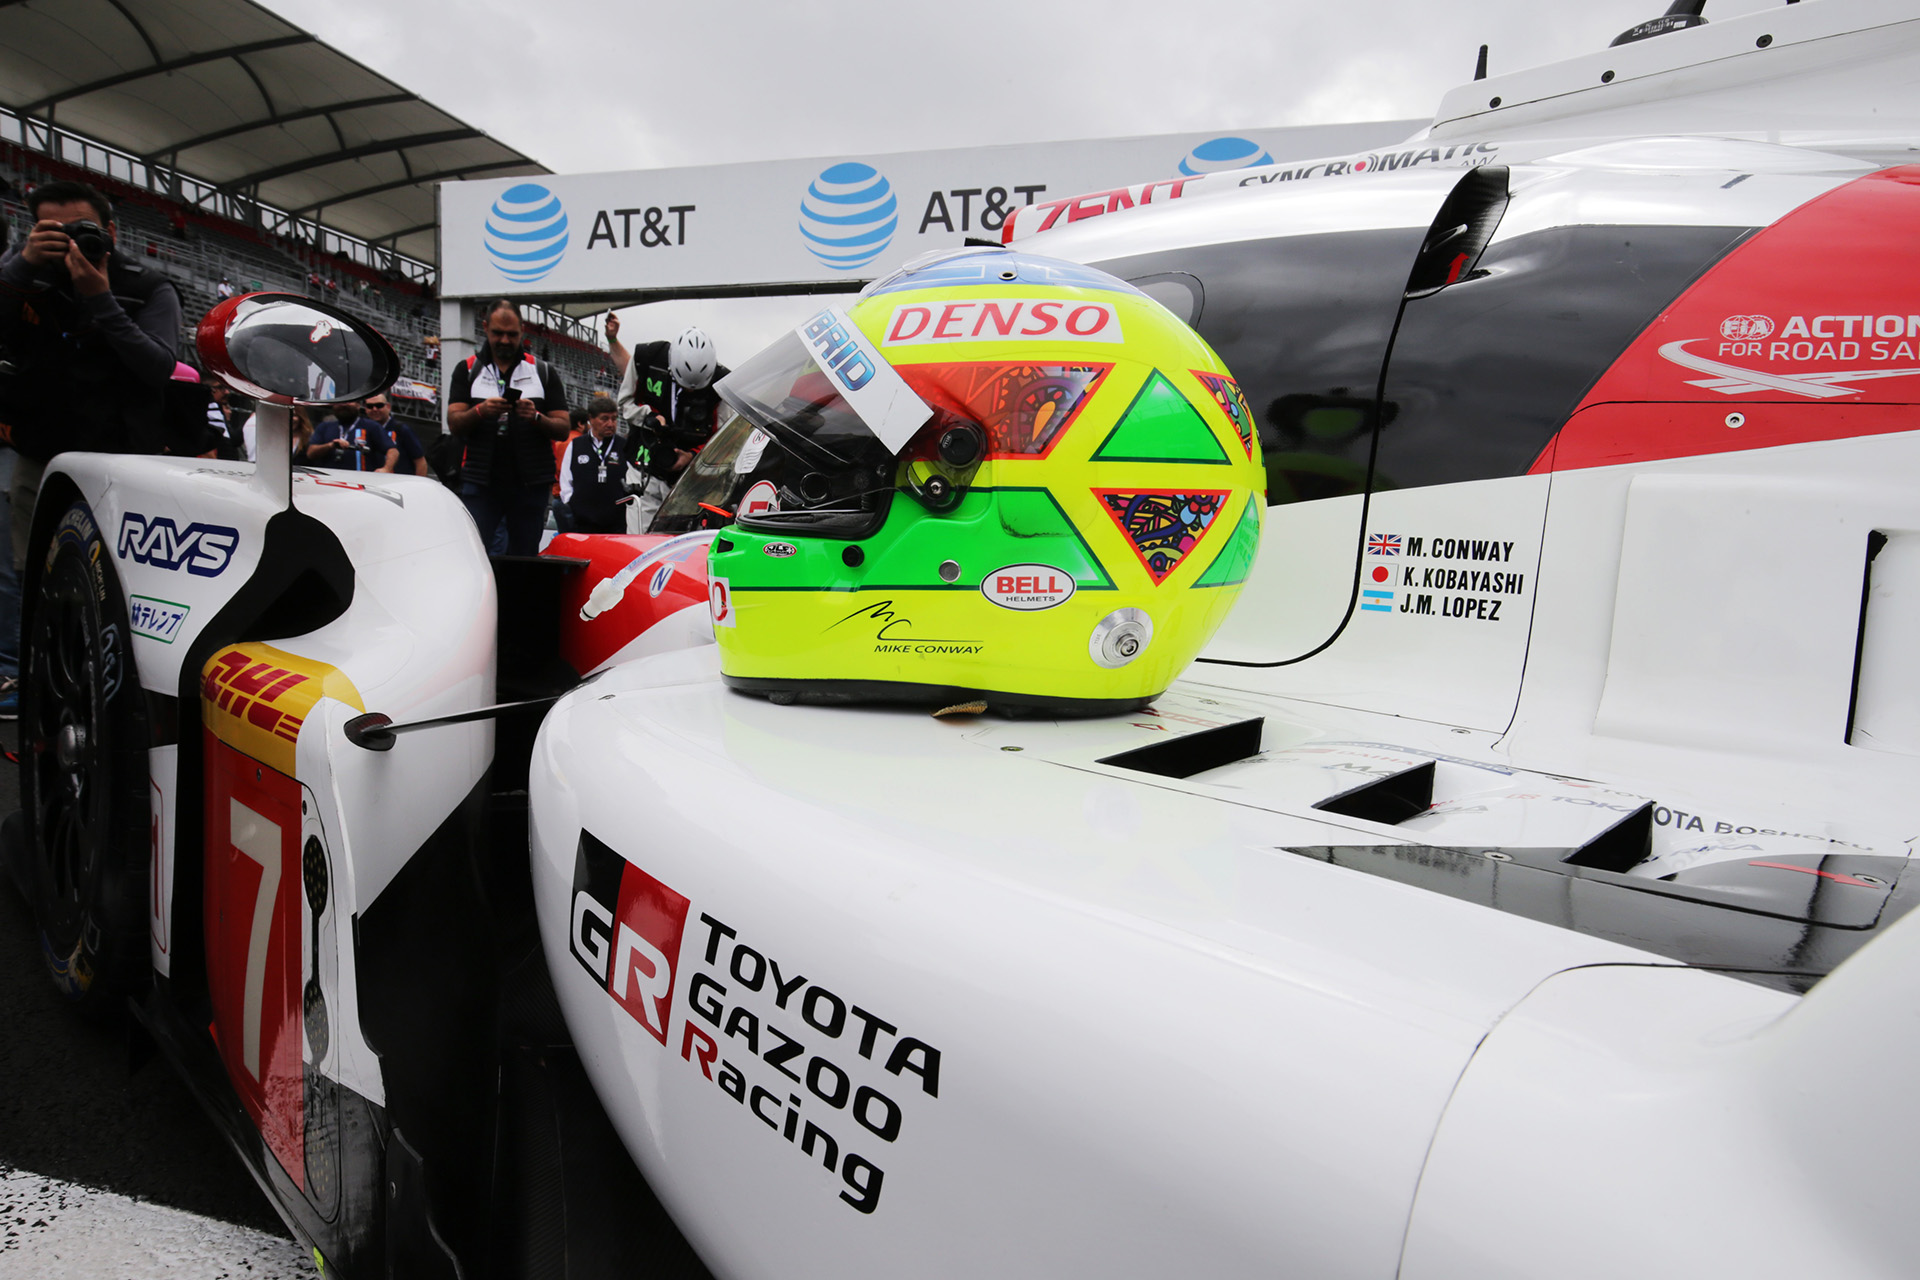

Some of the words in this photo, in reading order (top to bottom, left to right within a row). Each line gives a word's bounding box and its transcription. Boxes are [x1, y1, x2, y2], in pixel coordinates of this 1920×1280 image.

[587, 204, 696, 250] AT&T
[888, 302, 1110, 342] DENSO
[1718, 342, 1762, 356] FOR
[1769, 341, 1860, 361] ROAD
[118, 512, 239, 578] RAYS
[1406, 537, 1427, 557] M.
[1431, 538, 1514, 562] CONWAY
[996, 576, 1063, 593] BELL
[1403, 567, 1419, 587] K.
[1422, 568, 1524, 594] KOBAYASHI
[1400, 593, 1436, 616] J.M.
[1442, 596, 1502, 621] LOPEZ
[874, 645, 912, 653] MIKE
[914, 645, 983, 654] CONWAY
[202, 651, 310, 733] DHL
[1714, 821, 1875, 853] BOSHOKU
[230, 796, 282, 1085] 7
[572, 889, 672, 1037] GR
[700, 911, 942, 1099] TOYOTA
[688, 971, 903, 1144] GAZOO
[681, 1018, 886, 1215] Racing
